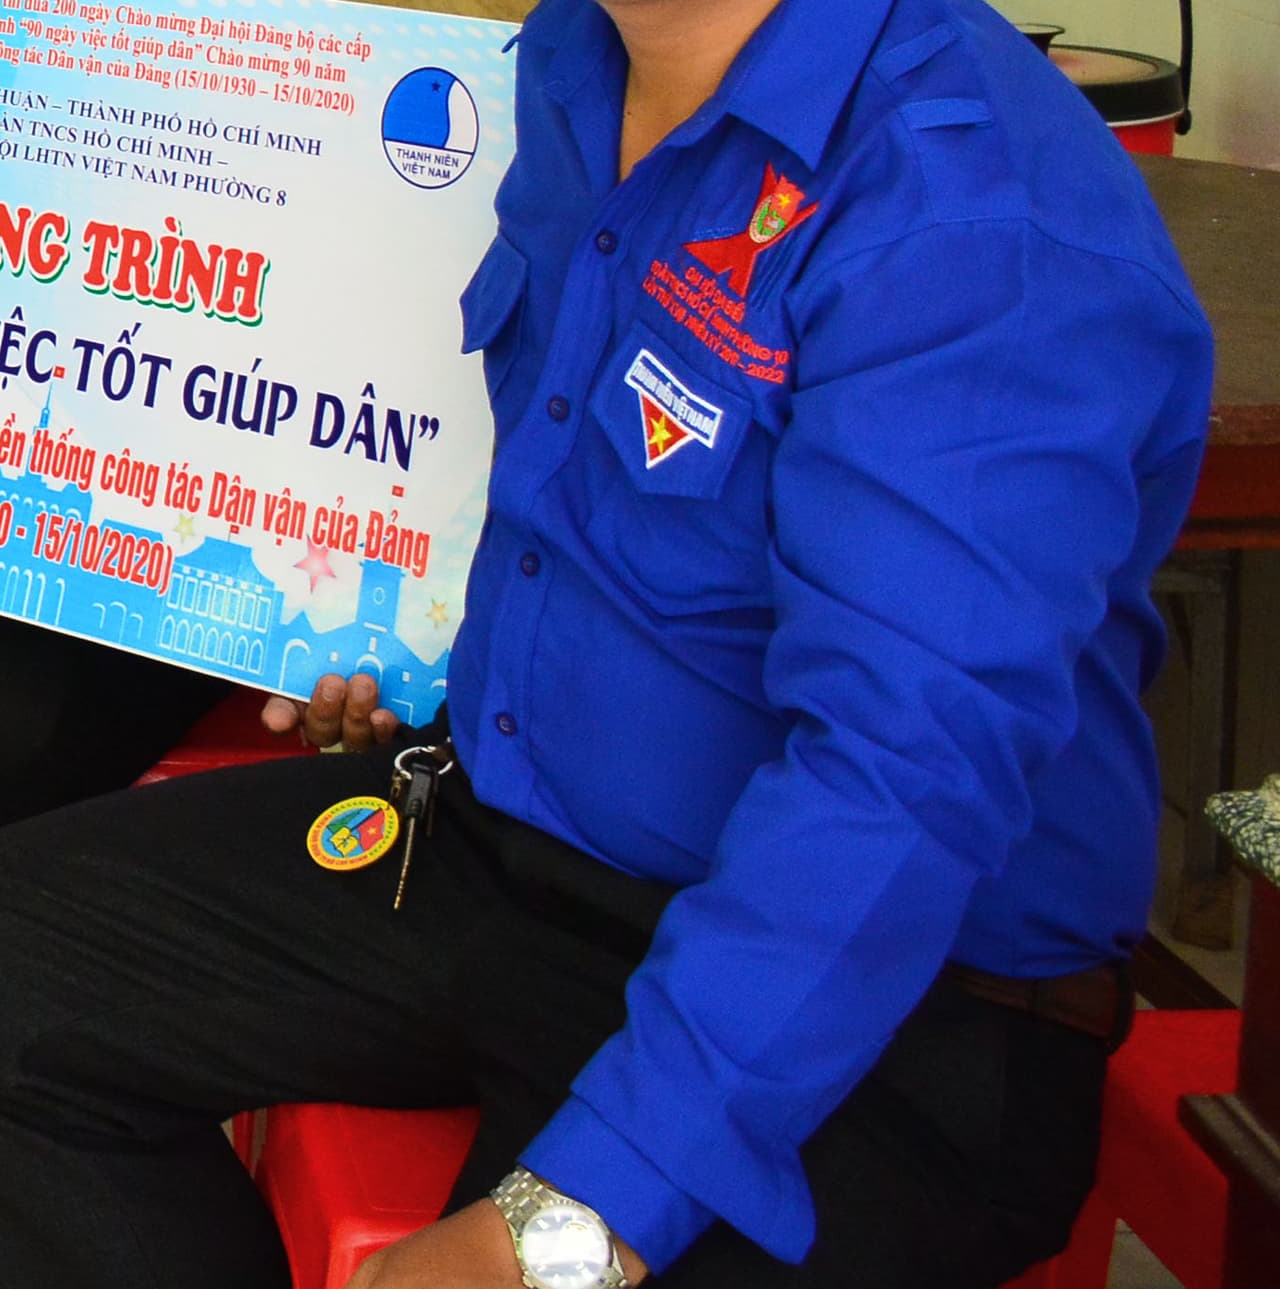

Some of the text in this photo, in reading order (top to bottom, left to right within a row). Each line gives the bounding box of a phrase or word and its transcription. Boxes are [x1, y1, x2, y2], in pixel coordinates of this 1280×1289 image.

[46, 24, 78, 47] ngày
[82, 28, 107, 51] việc
[111, 27, 129, 50] tốt
[133, 34, 164, 60] giúp
[206, 44, 244, 66] Chào
[248, 54, 290, 78] mừng
[294, 57, 311, 78] 90
[314, 62, 346, 83] năm
[80, 2, 112, 24] ngày
[116, 5, 152, 27] Chào
[156, 11, 196, 37] mừng
[200, 17, 225, 40] Đại
[228, 20, 251, 45] hội
[255, 24, 292, 51] Đảng
[297, 29, 314, 54] bộ
[319, 33, 342, 53] các
[345, 32, 372, 61] cấp
[24, 45, 43, 64] tác
[47, 48, 74, 69] Dân
[79, 54, 103, 77] vận
[106, 58, 130, 78] của
[135, 62, 171, 89] Đảng
[174, 68, 256, 97] (15/10/1930
[273, 83, 356, 116] 15/10/2020)
[29, 120, 77, 143] TNCS
[82, 128, 111, 149] HỒ
[117, 136, 153, 156] CHÍ
[158, 142, 213, 166] MINH
[68, 99, 136, 125] THÀNH
[141, 112, 182, 133] PHỐ
[187, 117, 218, 138] HỒ
[223, 124, 261, 146] CHÍ
[265, 131, 322, 156] MINH
[396, 148, 432, 162] THANH
[24, 145, 76, 168] LHTN
[81, 155, 127, 179] VIỆT
[131, 164, 178, 187] NAM
[183, 173, 272, 204] PHƯỜNG
[276, 190, 288, 207] 8
[428, 167, 451, 179] NAM
[82, 216, 270, 326] TRÌNH
[73, 322, 173, 409] TỐT
[182, 358, 299, 438] GIÚP
[30, 427, 96, 492] thống
[100, 448, 161, 508] công
[164, 461, 204, 514] tác
[263, 488, 308, 547] vận
[311, 496, 358, 555] của
[362, 510, 432, 579] Đảng
[31, 512, 174, 596] 15/10/2020)
